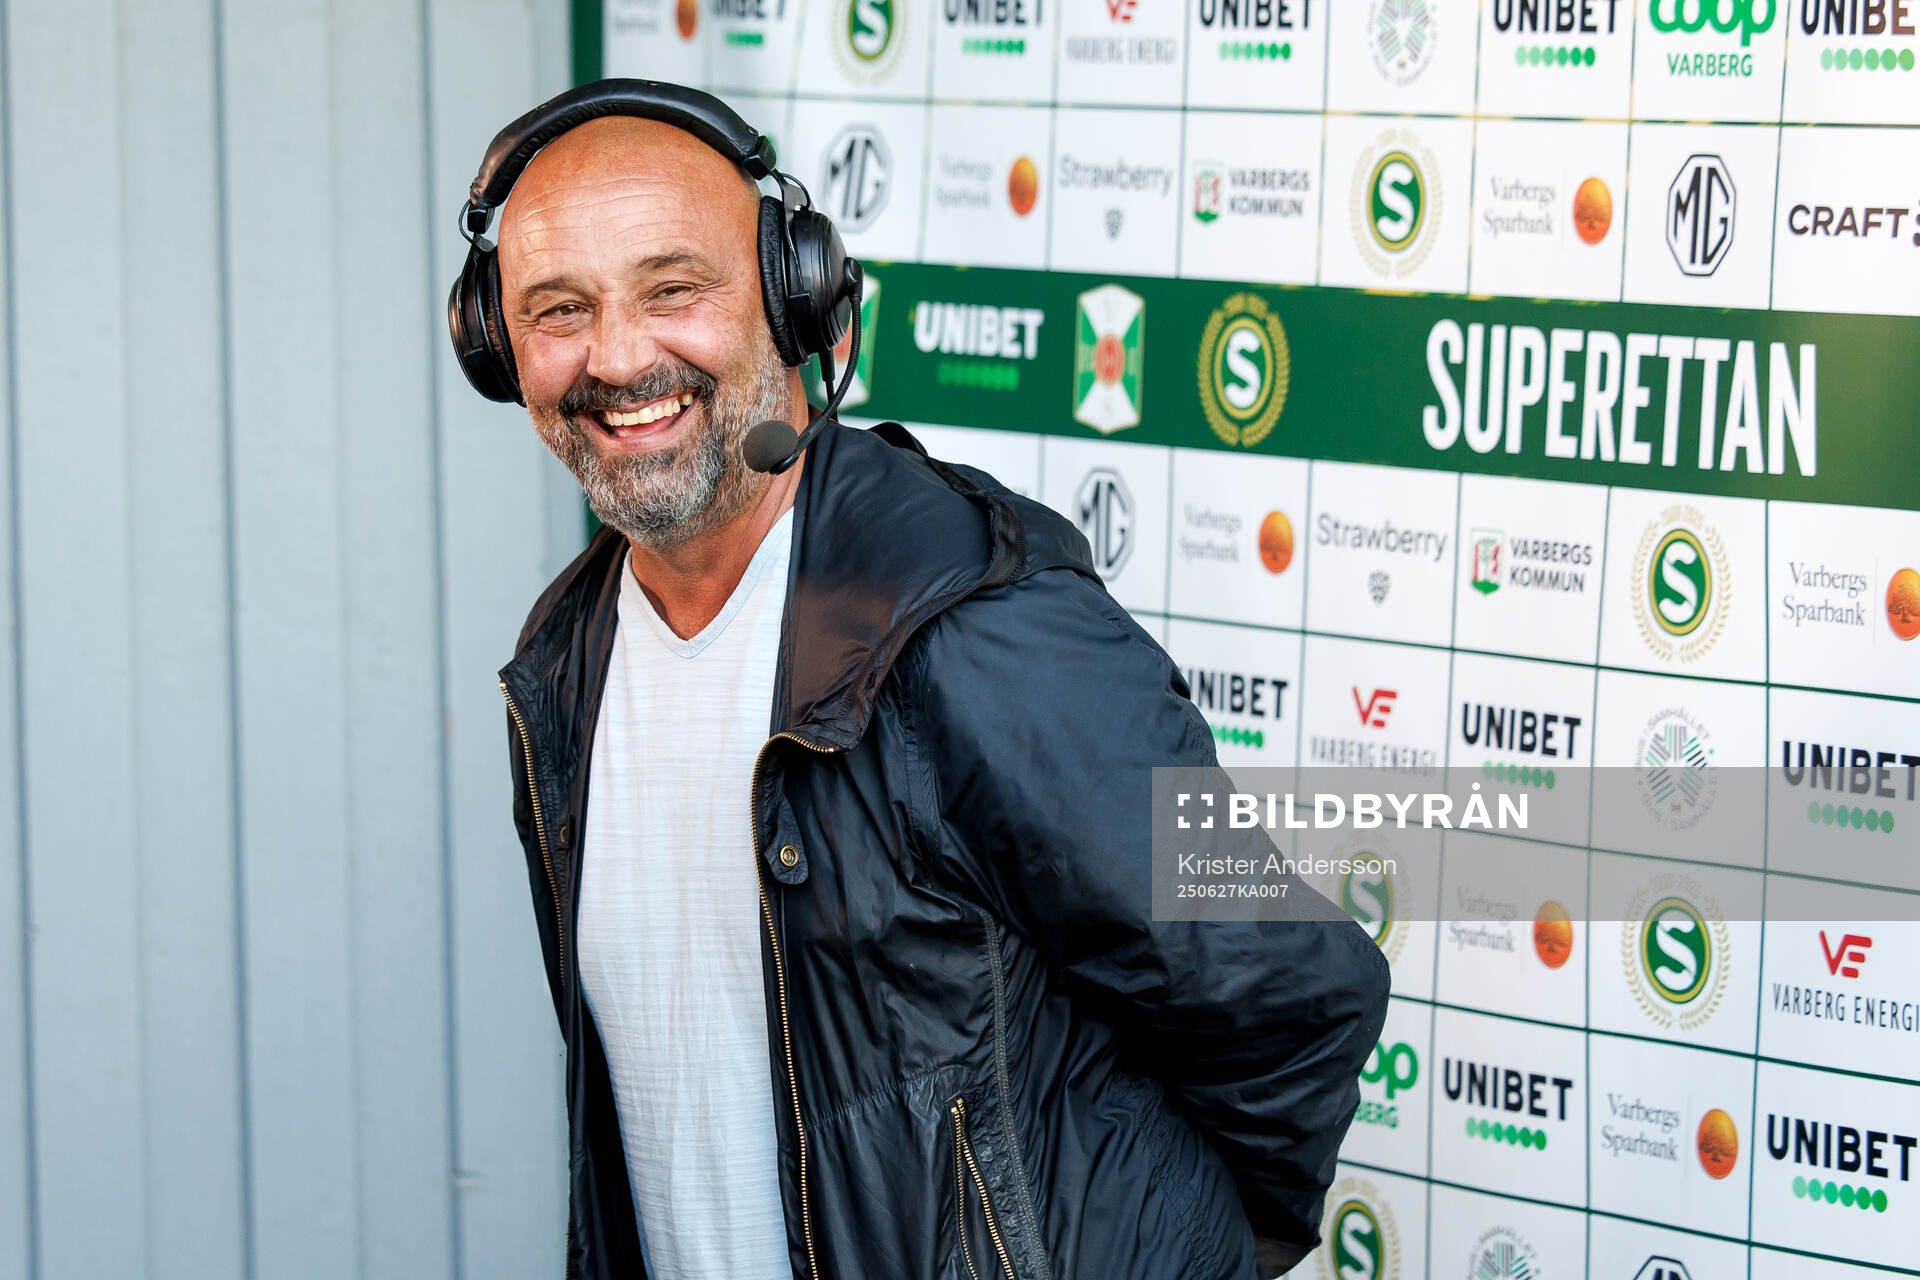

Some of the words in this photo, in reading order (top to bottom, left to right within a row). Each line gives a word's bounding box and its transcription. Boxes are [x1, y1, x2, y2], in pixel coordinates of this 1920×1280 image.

[1494, 0, 1617, 33] UNIBET
[1801, 0, 1915, 36] UNIBE
[1667, 54, 1753, 77] VARBERG
[1059, 156, 1174, 197] Strawberry
[1229, 168, 1310, 192] VARBERGS
[1490, 176, 1556, 208] Varbergs
[1228, 197, 1303, 217] KOMMUN
[1483, 211, 1554, 240] Sparbank
[1788, 204, 1909, 239] CRAFT
[914, 301, 1045, 360] UNIBET
[1422, 319, 1817, 477] SUPERETTAN
[1317, 512, 1448, 562] Strawberry
[1510, 537, 1592, 566] VARBERGS
[1509, 566, 1585, 593] KOMMUN
[1789, 561, 1867, 598] Varbergs
[1782, 595, 1865, 627] Sparbank
[1462, 702, 1581, 759] UNIBET
[1783, 740, 1920, 801] UNIBET
[1773, 982, 1845, 1021] VARBERG
[1854, 995, 1920, 1033] ENERGI
[1360, 1041, 1418, 1099] op
[1444, 1057, 1572, 1121] UNIBET
[1607, 1092, 1680, 1133] Varbergs
[1601, 1124, 1678, 1161] Sparbank
[1767, 1114, 1917, 1181] UNIBET
